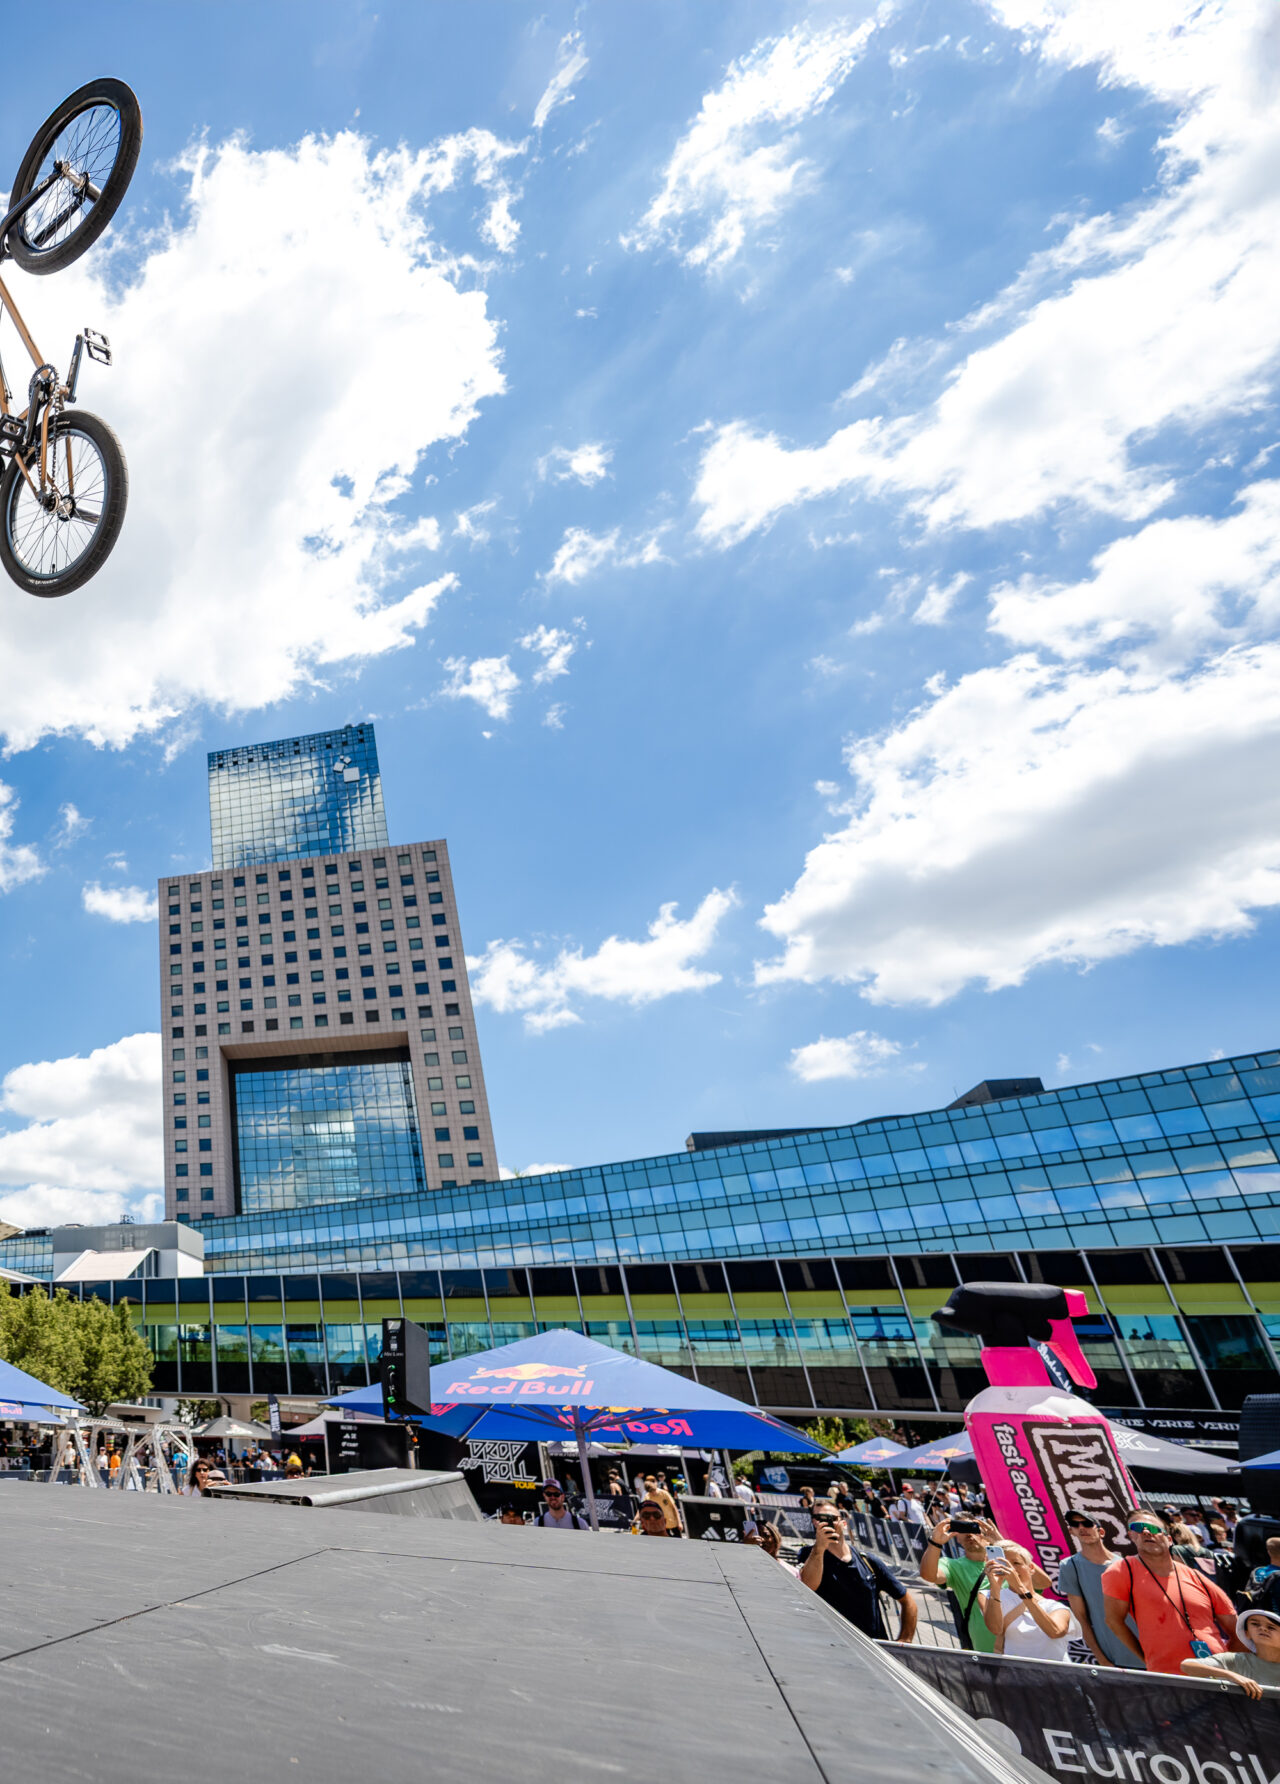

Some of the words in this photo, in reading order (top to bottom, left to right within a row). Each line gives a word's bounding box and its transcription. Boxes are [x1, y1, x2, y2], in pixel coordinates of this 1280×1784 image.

[445, 1381, 513, 1395] Red
[519, 1380, 595, 1396] Bull
[0, 1406, 23, 1415] Bull
[1110, 1417, 1145, 1428] RDE
[1147, 1419, 1196, 1429] VERDE
[466, 1440, 529, 1462] DROP
[480, 1459, 538, 1484] ROLL
[513, 1480, 536, 1490] TOUR
[993, 1423, 1027, 1467] fast
[1011, 1468, 1051, 1542] action
